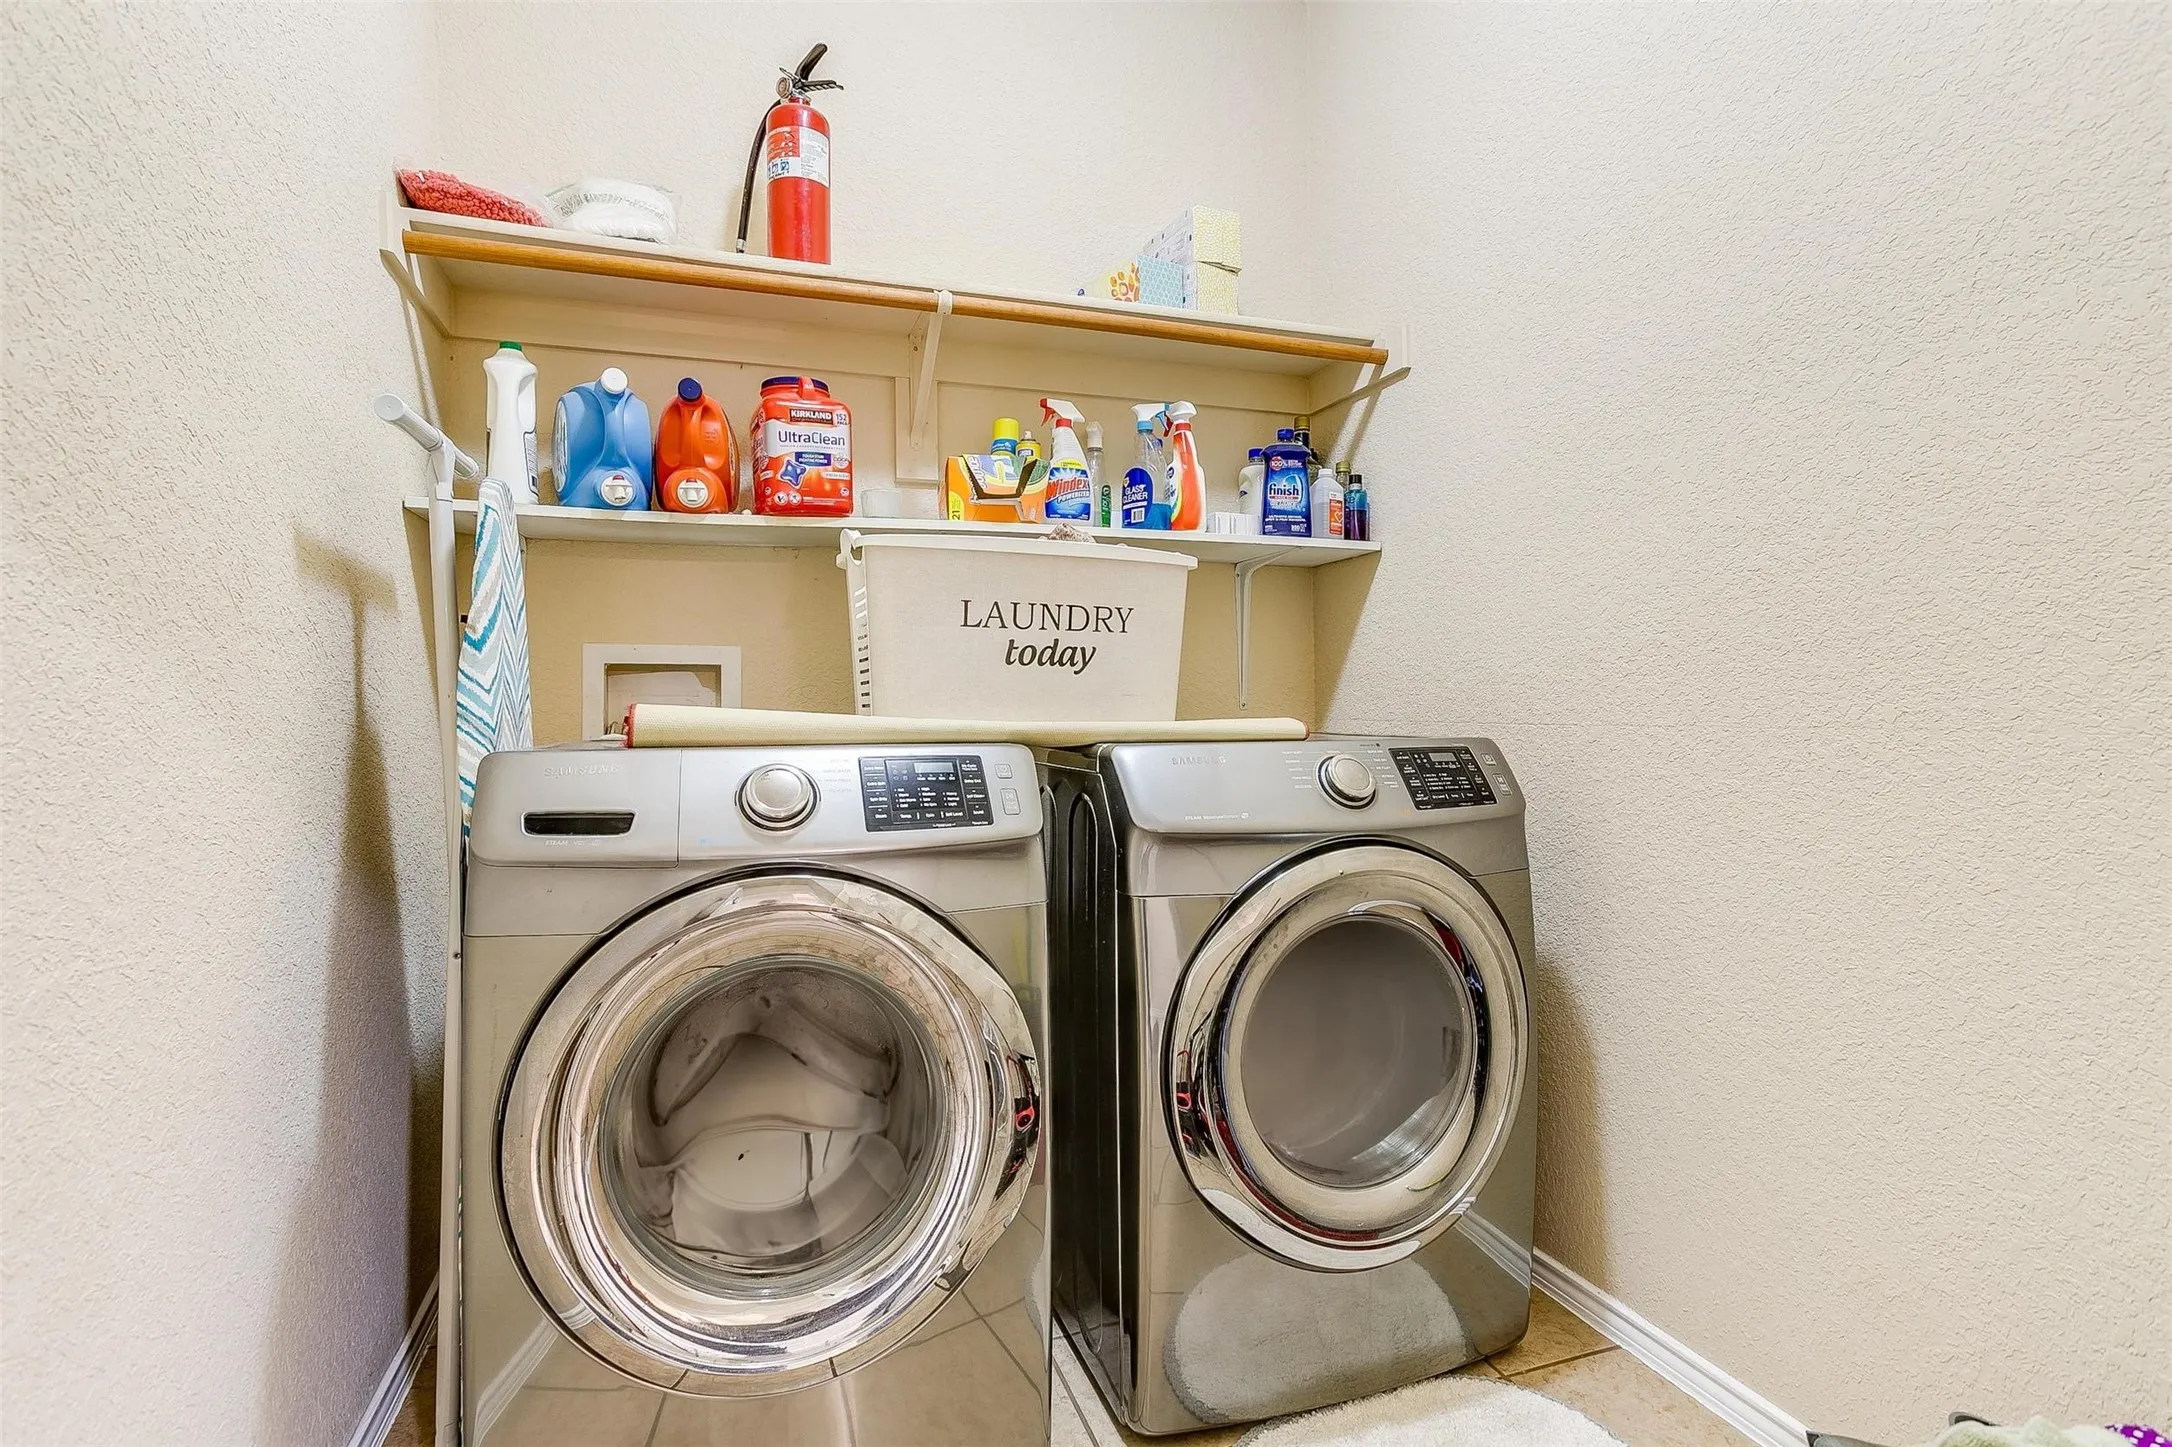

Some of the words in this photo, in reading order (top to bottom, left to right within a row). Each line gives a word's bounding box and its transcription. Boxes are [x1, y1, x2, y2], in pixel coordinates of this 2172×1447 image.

[790, 409, 832, 420] KIRKLAND
[835, 413, 847, 421] 152
[778, 430, 846, 446] UltraClean
[1045, 477, 1088, 501] Windex
[1269, 482, 1299, 496] finish
[1123, 491, 1148, 504] CLEANER
[952, 510, 961, 520] 21
[960, 599, 1135, 634] LAUNDRY
[1005, 638, 1097, 675] today
